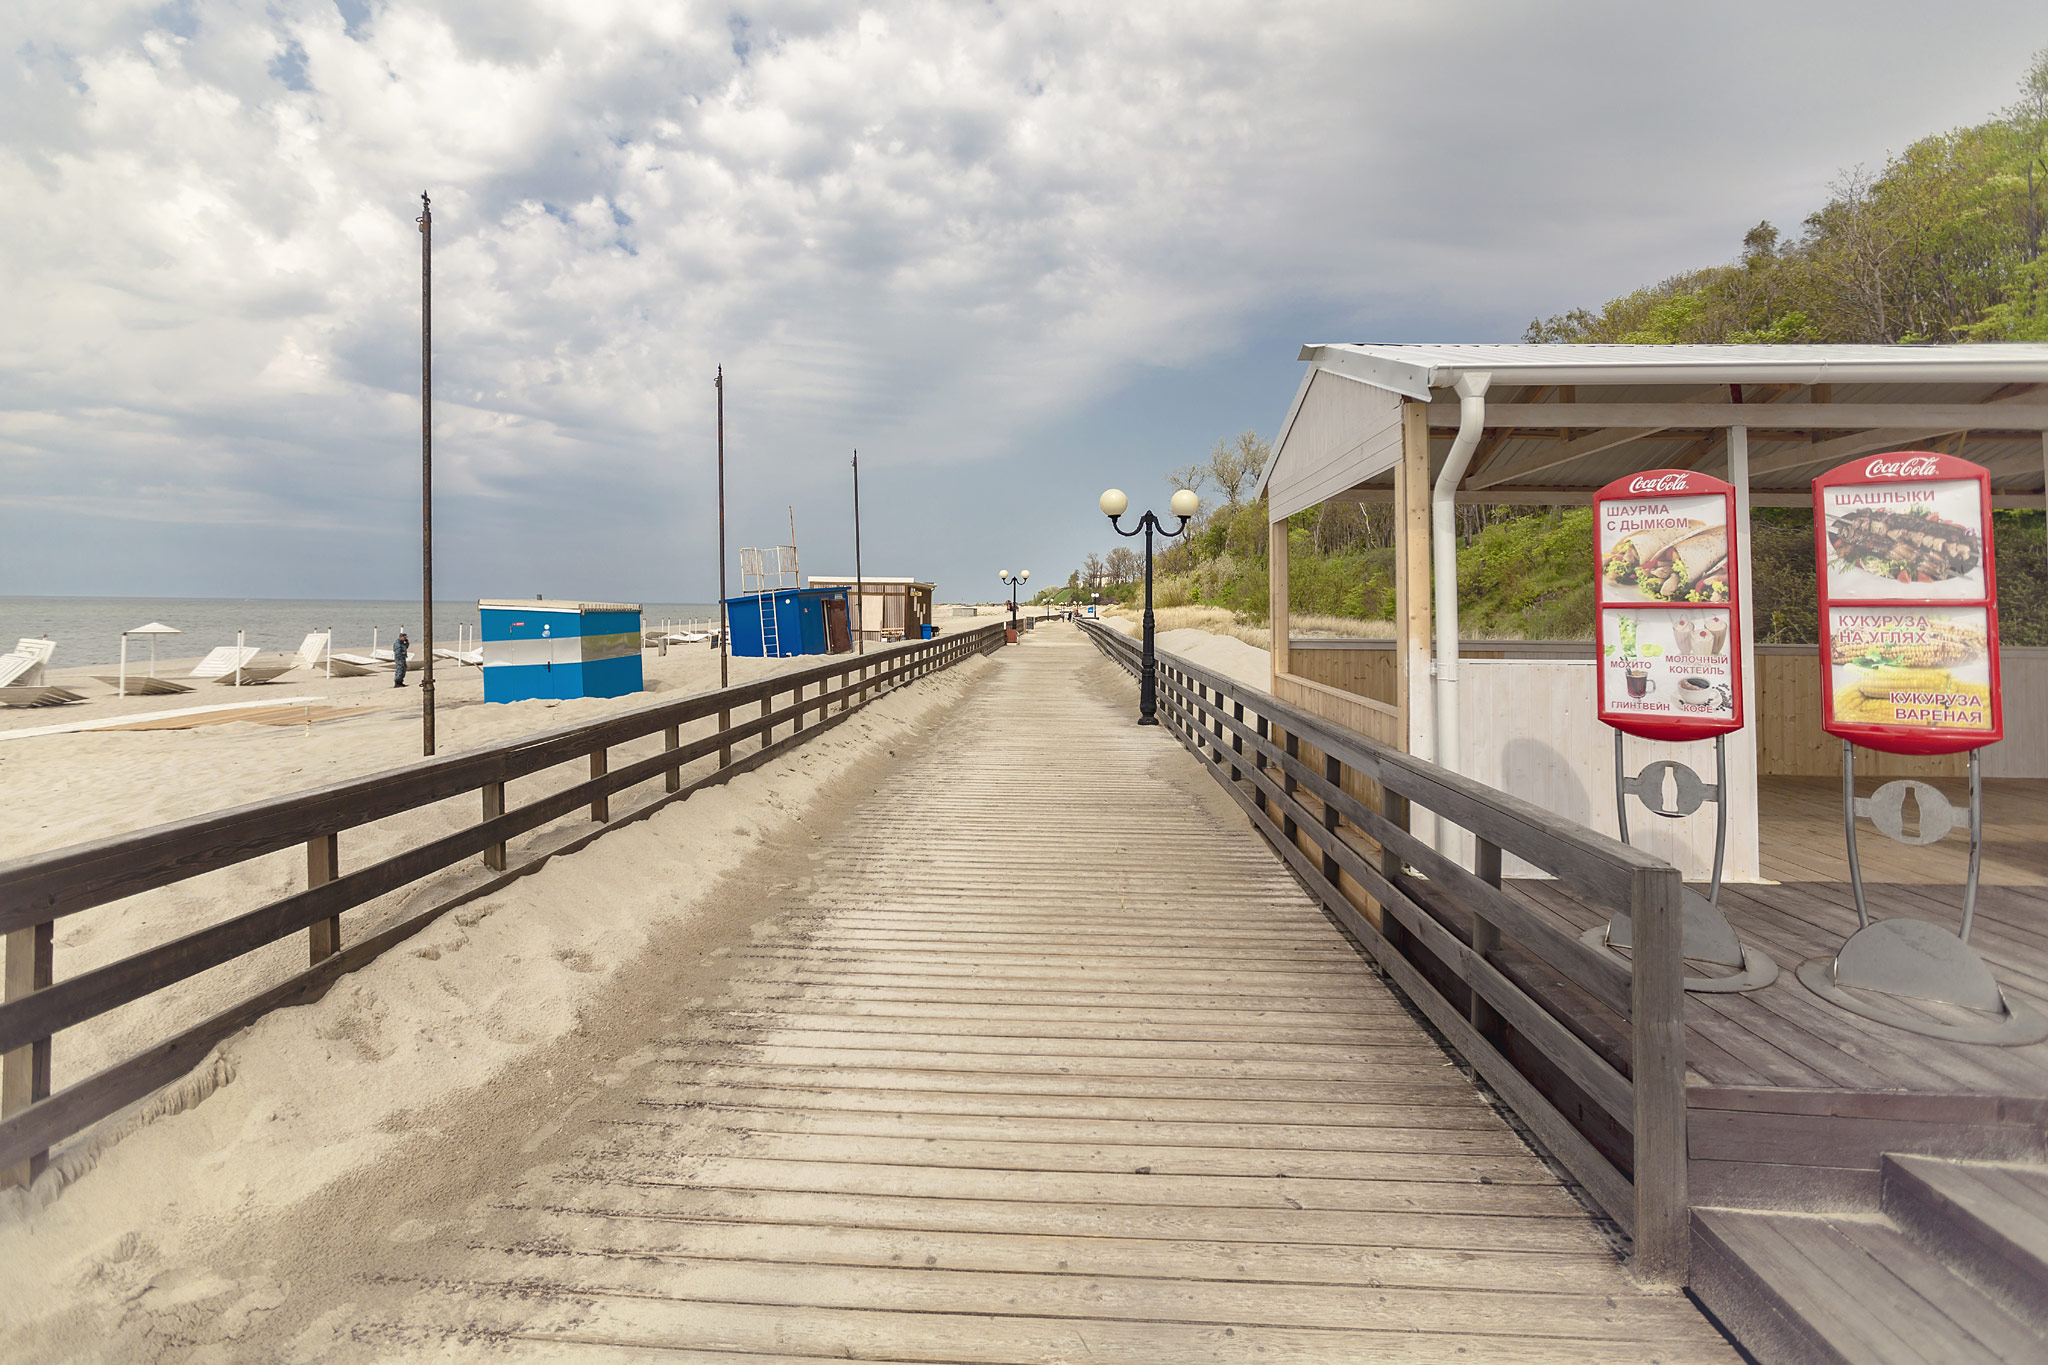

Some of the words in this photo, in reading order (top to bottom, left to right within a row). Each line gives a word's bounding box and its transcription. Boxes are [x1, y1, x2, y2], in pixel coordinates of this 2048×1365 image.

[1835, 490, 1935, 506] ШАШЛЫКИ
[1607, 504, 1669, 517] ШАУРМА
[1607, 521, 1616, 531] С
[1620, 518, 1688, 532] ДЫМКОМ
[1838, 615, 1929, 628] КУКУРУЗА
[1839, 631, 1864, 643] НА
[1869, 631, 1927, 644] УГЛЯХ
[1610, 660, 1652, 669] МОХИТО
[1665, 655, 1729, 664] МОЛОЧНЫЙ
[1669, 665, 1725, 675] КОКТЕЙЛЬ
[1611, 701, 1671, 711] ГЛИНТВЕЙН
[1890, 692, 1982, 707] КУКУРУЗА
[1683, 704, 1713, 713] КОФЕ
[1895, 708, 1982, 723] ВАРЕНАЯ
